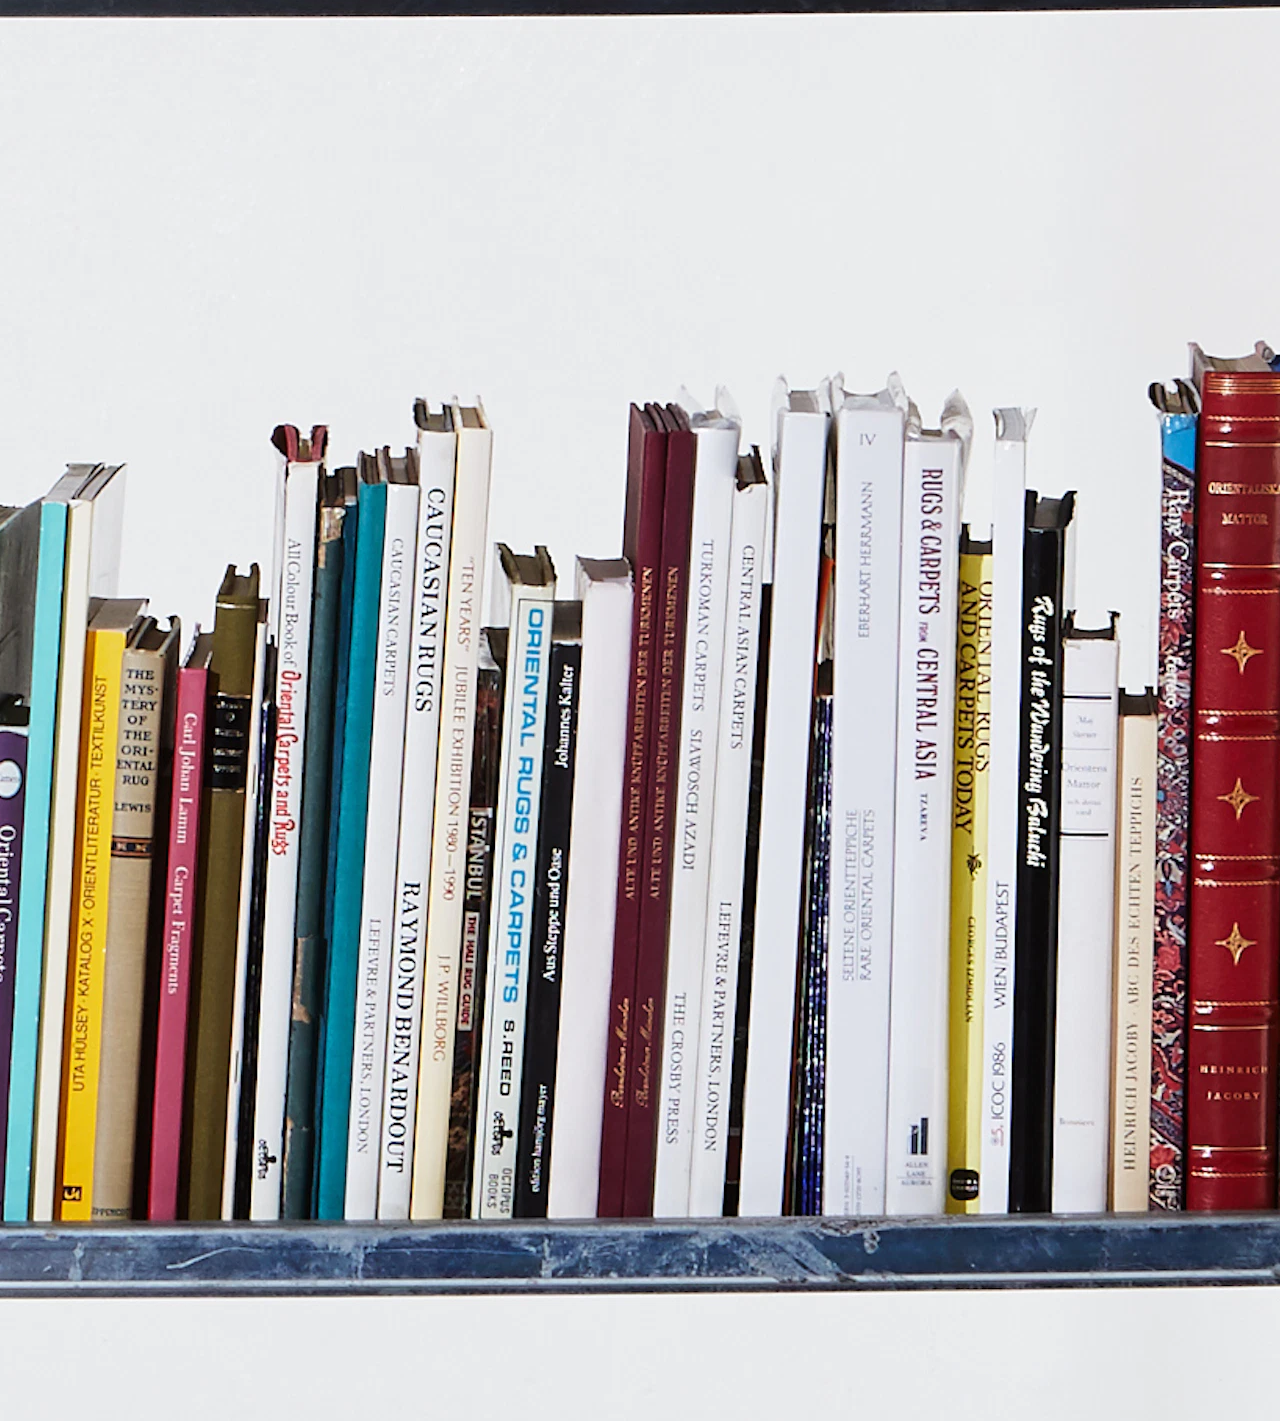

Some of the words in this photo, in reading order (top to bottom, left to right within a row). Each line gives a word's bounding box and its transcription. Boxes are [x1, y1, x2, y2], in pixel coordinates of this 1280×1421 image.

[418, 487, 445, 639] CAUCASIAN
[1026, 649, 1051, 668] of
[1030, 595, 1055, 643] Rugs
[413, 645, 436, 714] RUGS
[520, 607, 545, 747] ORIENTAL
[1029, 673, 1051, 698] the
[1023, 700, 1050, 793] Wandering
[514, 755, 537, 835] RUGS
[1024, 797, 1048, 869] Baluchi
[511, 841, 533, 864] &
[394, 881, 422, 1006] RAYMOND
[503, 871, 530, 1004] CARPETS
[386, 1014, 416, 1173] BENARDOUT
